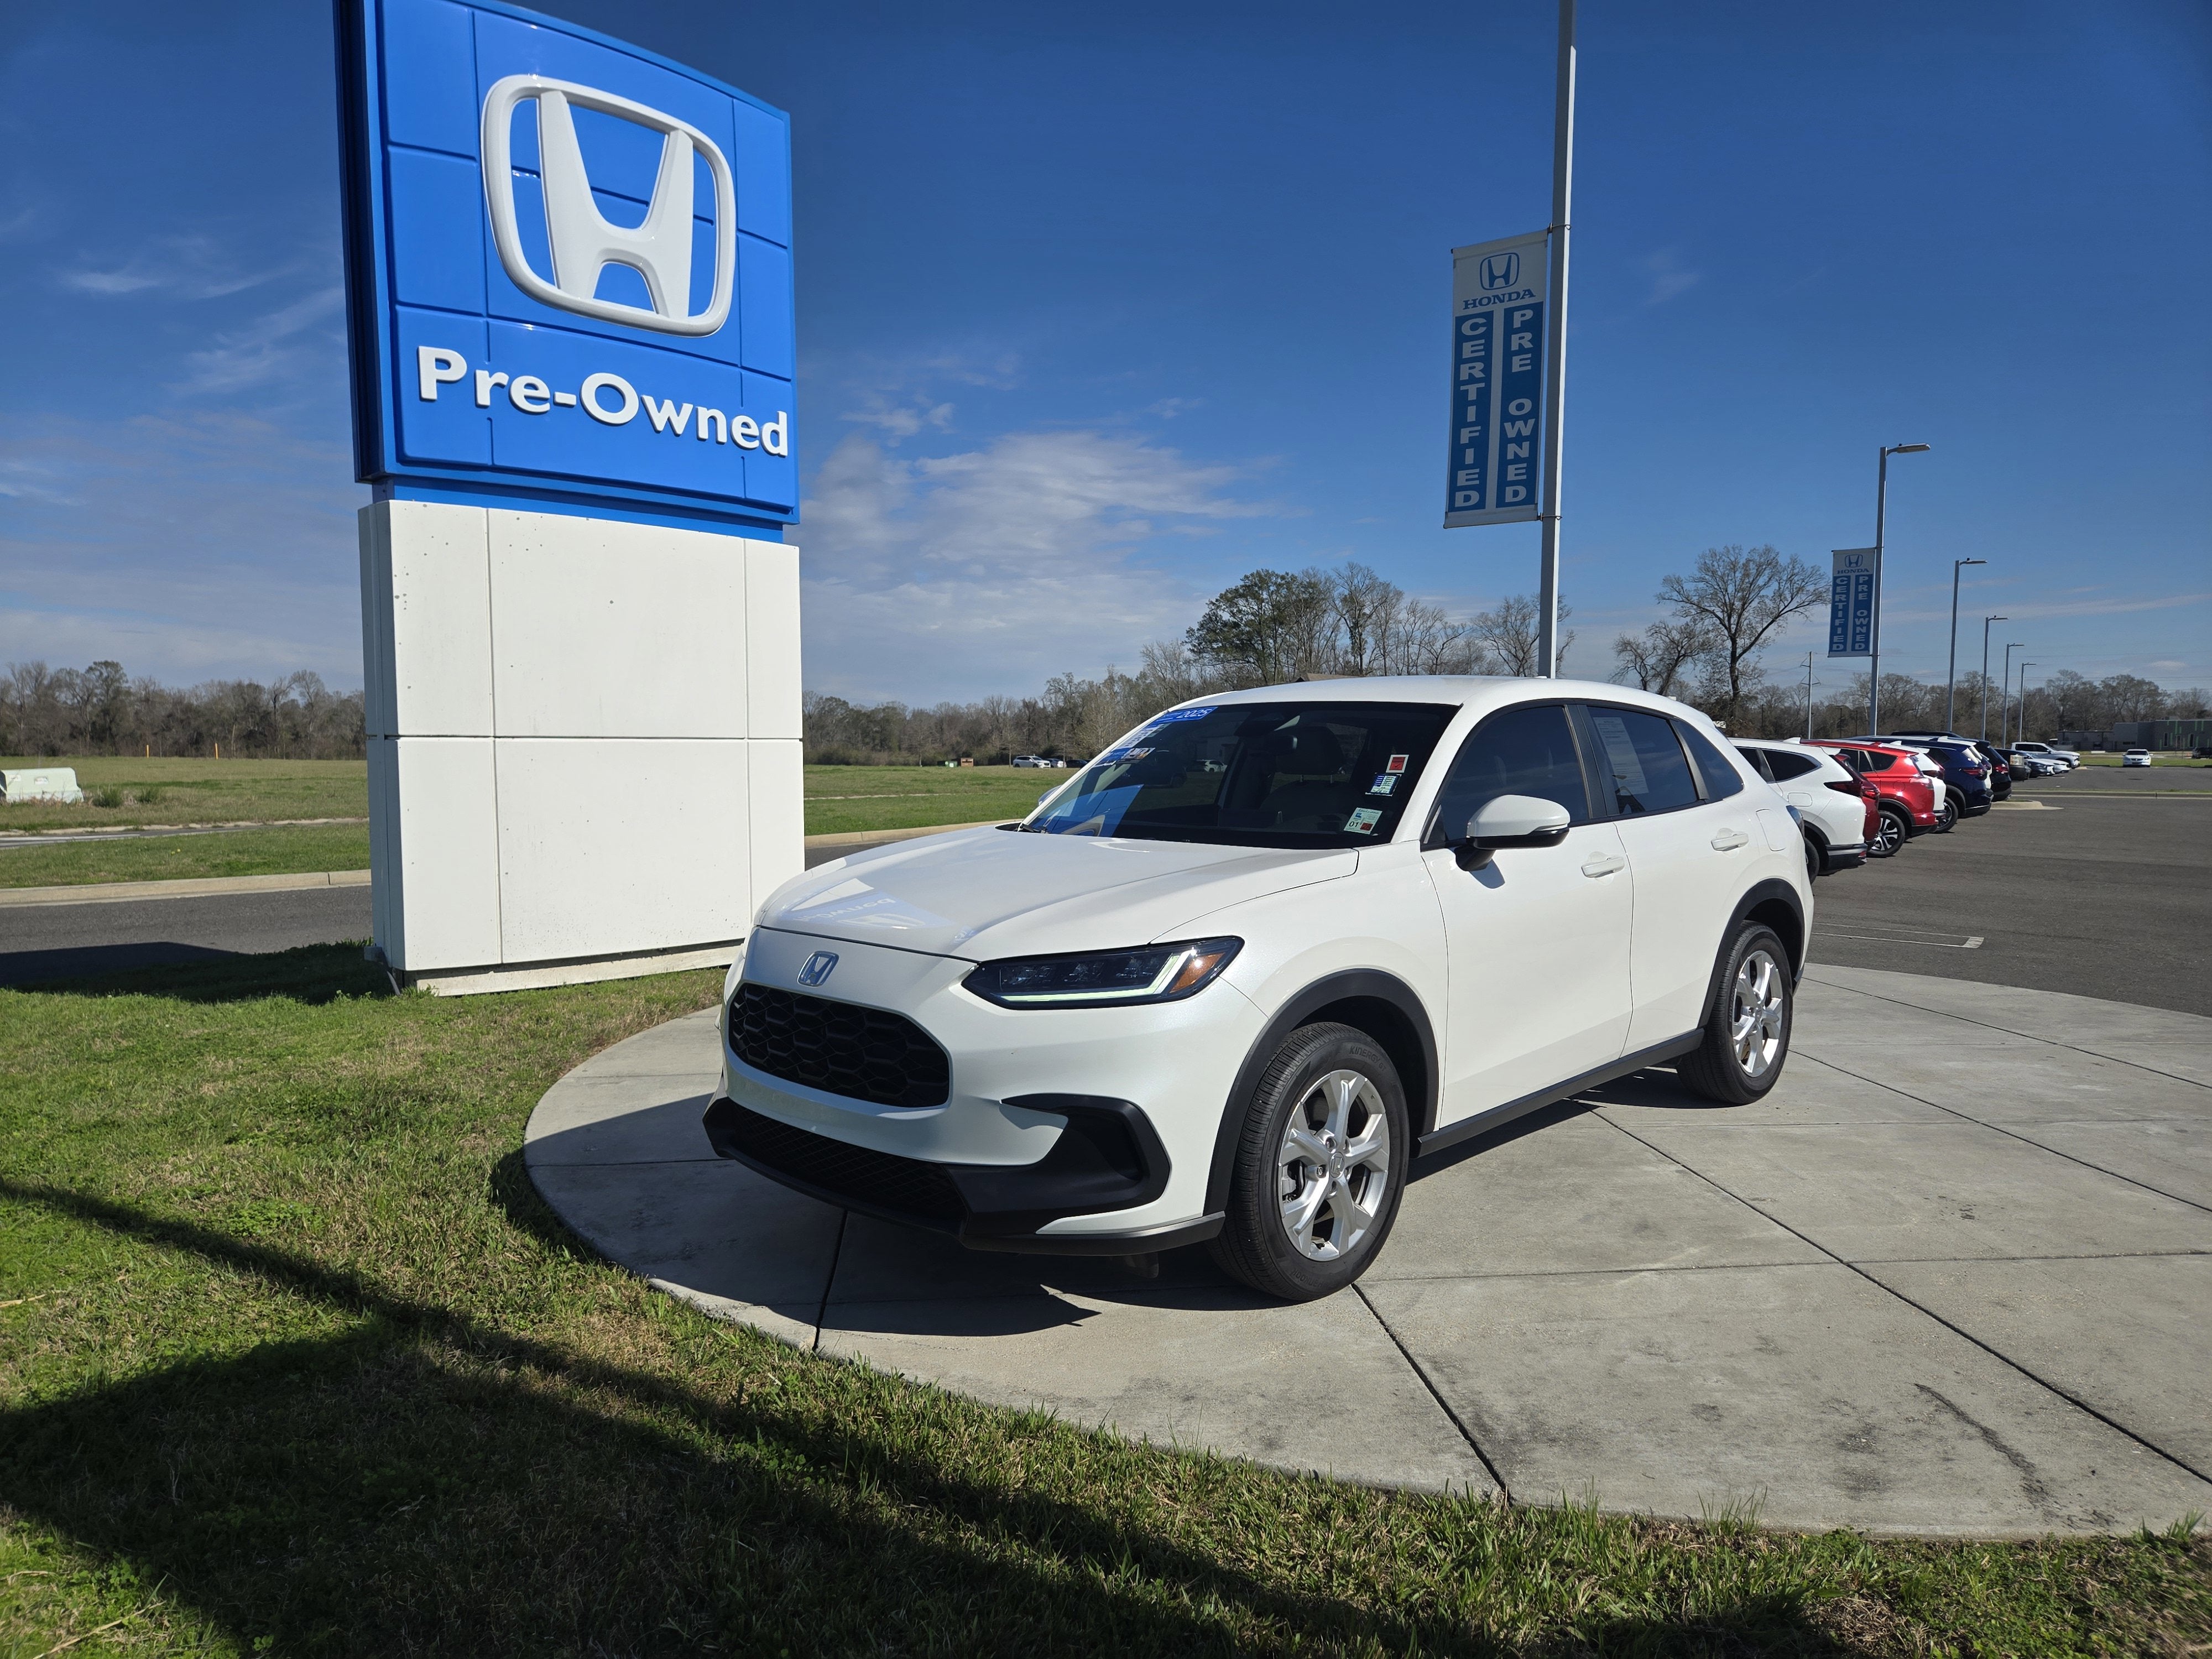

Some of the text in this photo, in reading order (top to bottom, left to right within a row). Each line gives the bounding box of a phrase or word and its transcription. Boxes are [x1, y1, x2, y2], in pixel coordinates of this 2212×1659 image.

[1463, 288, 1536, 310] HONDA
[417, 345, 788, 457] Pre-Owned
[1454, 318, 1487, 507] CERTIFIED
[1504, 308, 1536, 503] PRE OWNED
[1833, 577, 1848, 650] CERTIFIED
[1855, 576, 1869, 650] PRE OWNED
[1176, 709, 1212, 718] 2025
[1349, 1045, 1381, 1063] KINERGY
